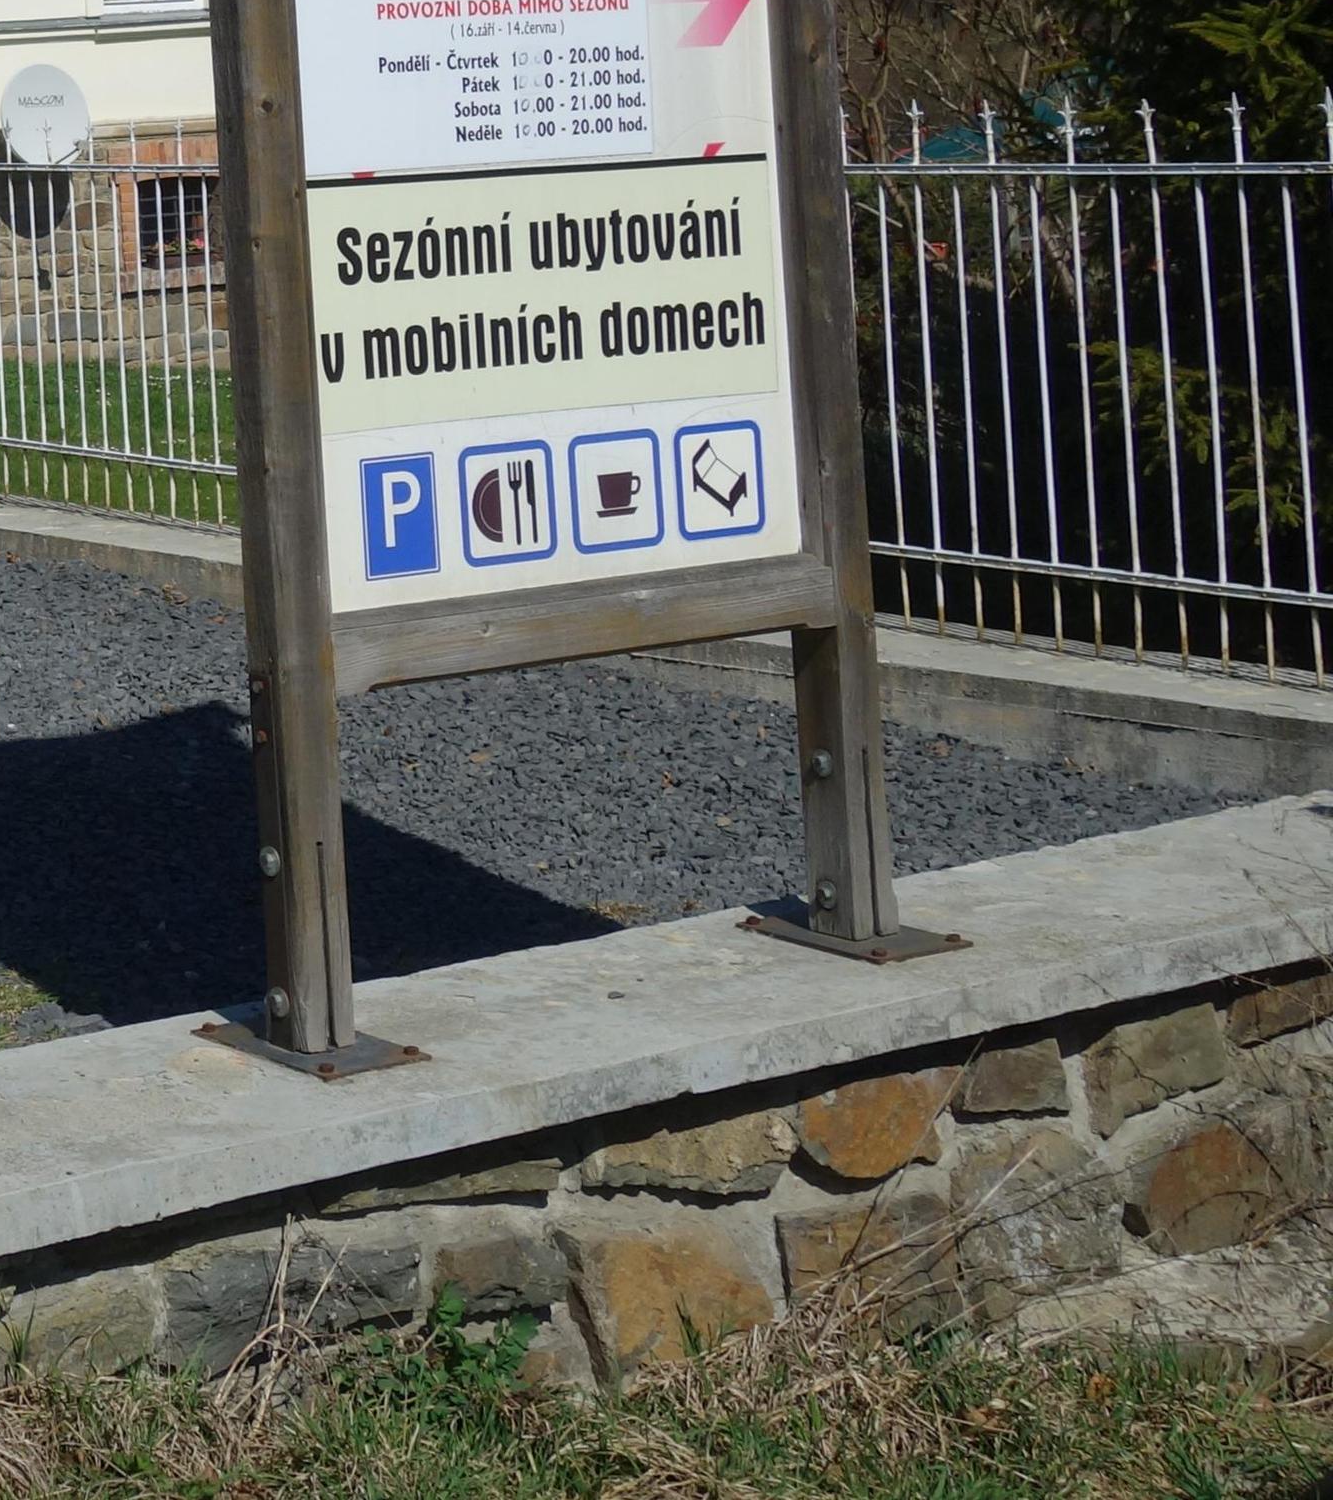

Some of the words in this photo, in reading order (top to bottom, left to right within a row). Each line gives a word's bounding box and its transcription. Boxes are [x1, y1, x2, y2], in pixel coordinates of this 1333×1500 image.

[468, 0, 513, 16] DOBA
[378, 55, 430, 73] Pondělí
[446, 50, 500, 71] Čtvrtek
[569, 47, 610, 64] 20.00
[616, 45, 644, 61] hod.
[462, 75, 500, 93] Pátek
[570, 70, 611, 87] 21.00
[616, 68, 645, 85] hod.
[18, 95, 64, 107] MASCOM
[454, 100, 501, 118] Sobota
[571, 93, 612, 111] 21.00
[617, 91, 646, 108] hod.
[455, 125, 503, 143] Neděle
[572, 117, 613, 135] 20.00
[618, 116, 647, 132] hod.
[336, 211, 513, 286] Sezónní
[529, 196, 742, 272] ubytování
[320, 332, 345, 382] v
[364, 304, 583, 380] mobilních
[599, 292, 765, 358] domech
[382, 470, 421, 548] P
